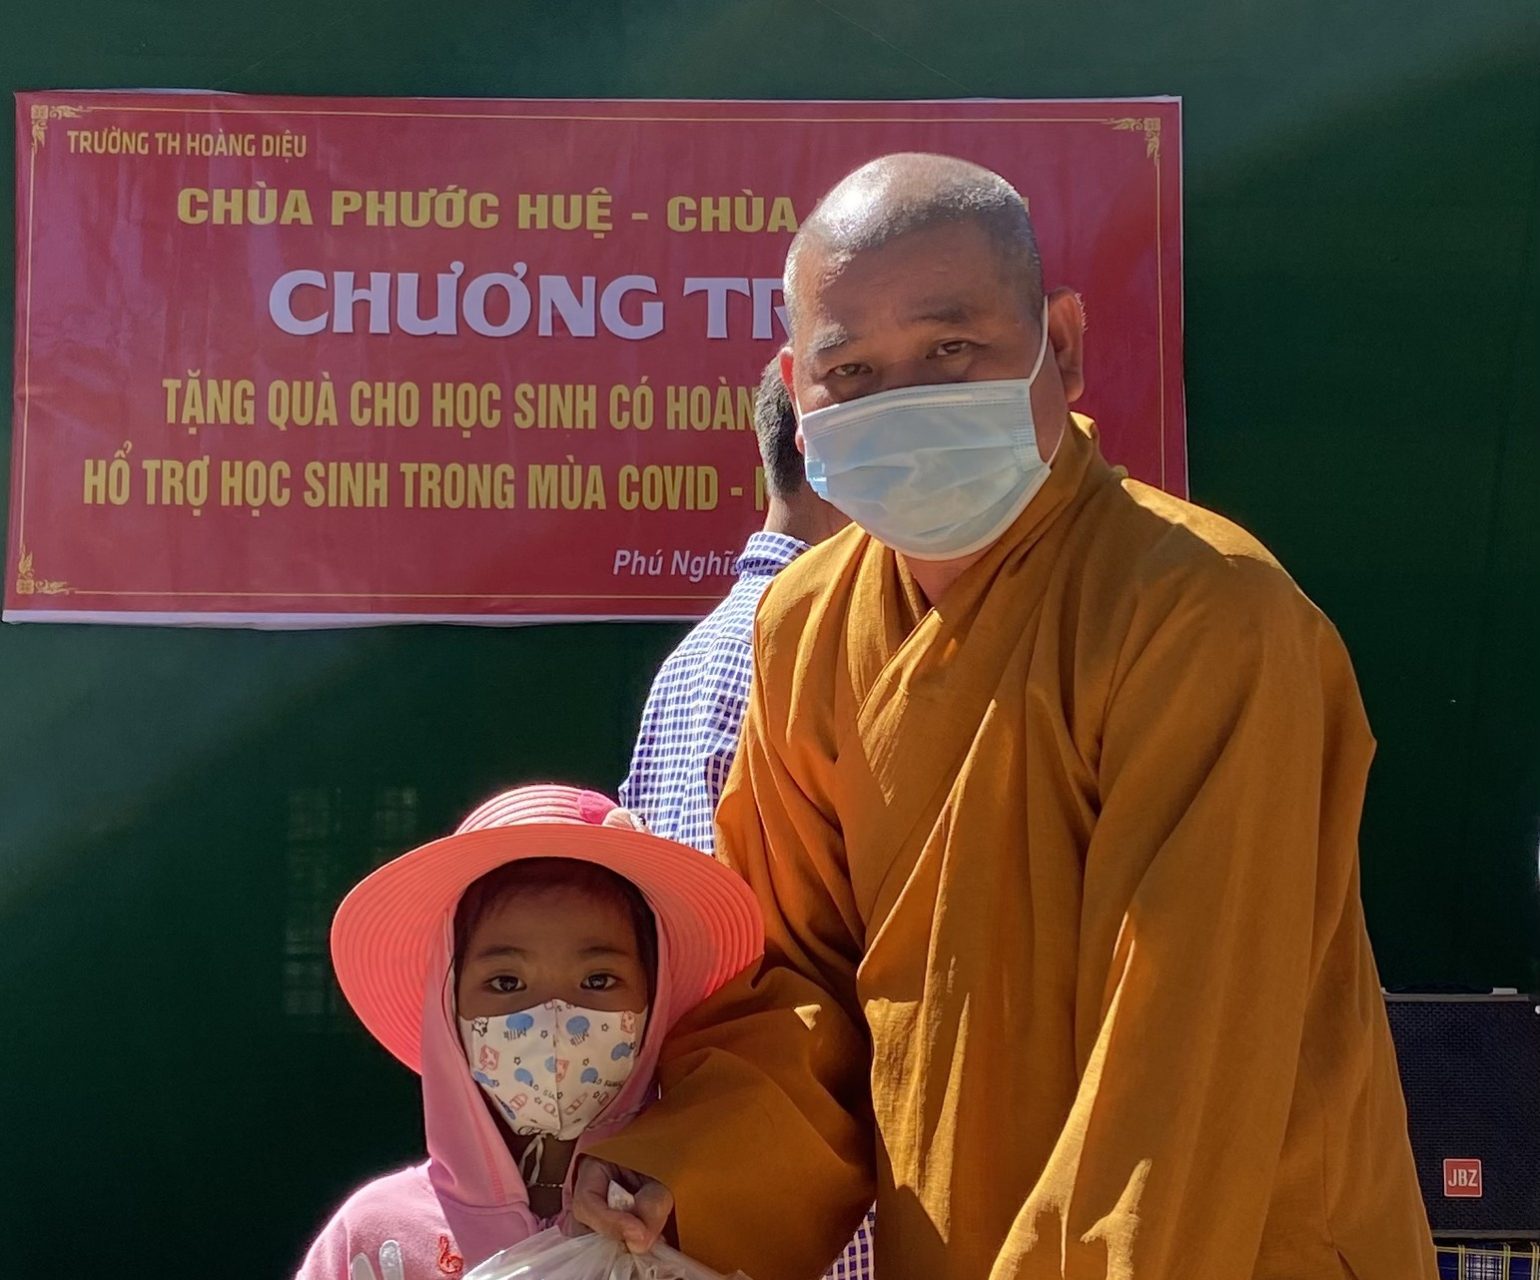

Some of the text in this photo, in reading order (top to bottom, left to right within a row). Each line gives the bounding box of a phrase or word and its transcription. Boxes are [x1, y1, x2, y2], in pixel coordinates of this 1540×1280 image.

[67, 126, 307, 163] TRƯỜNG TH HOÀNG DIỆU
[177, 181, 313, 225] CHÙA
[331, 185, 499, 229] PHƯỚC
[517, 187, 612, 239] HUỆ
[667, 188, 800, 232] CHÙA
[268, 261, 664, 340] CHƯƠNG
[162, 368, 256, 435] TẶNG
[268, 371, 338, 431] QUÀ
[350, 381, 419, 428] CHO
[432, 382, 501, 438] HỌC
[514, 383, 597, 430] SINH
[609, 376, 653, 430] CÓ
[83, 440, 132, 505] HỔ
[142, 455, 210, 517] TRỢ
[220, 460, 291, 517] HỌC
[303, 461, 388, 508] SINH
[400, 463, 515, 509] TRONG
[527, 454, 606, 510] MÙA
[618, 464, 718, 511] COVID
[613, 550, 663, 576] Phú
[1447, 1168, 1478, 1187] JBZ
